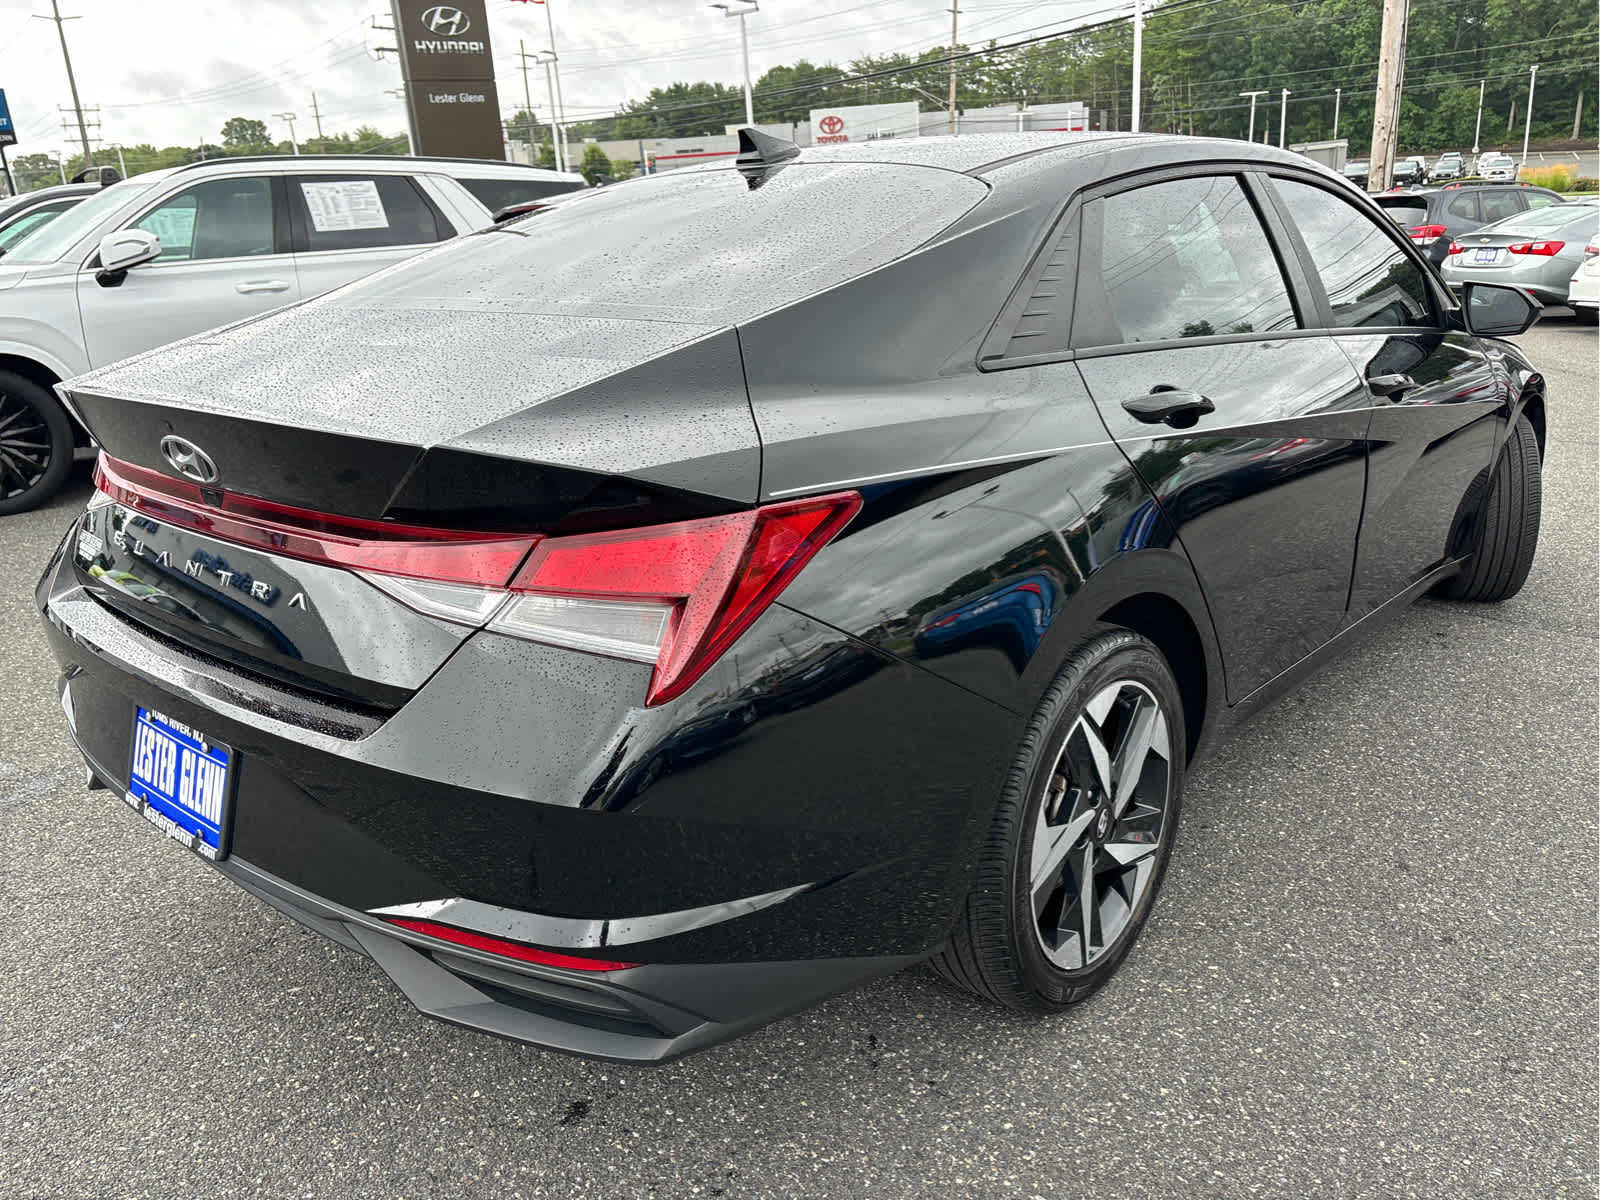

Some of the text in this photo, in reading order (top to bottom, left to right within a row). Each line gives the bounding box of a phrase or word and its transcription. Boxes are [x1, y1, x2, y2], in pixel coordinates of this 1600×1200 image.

[414, 40, 484, 54] HYUNDAI
[429, 92, 486, 103] Lester Glenn
[816, 134, 849, 144] TOYOTA
[113, 529, 307, 611] ELANTRA
[192, 729, 204, 744] NJ
[133, 721, 226, 826] LESTER GLENN
[143, 803, 193, 848] lesterglenn
